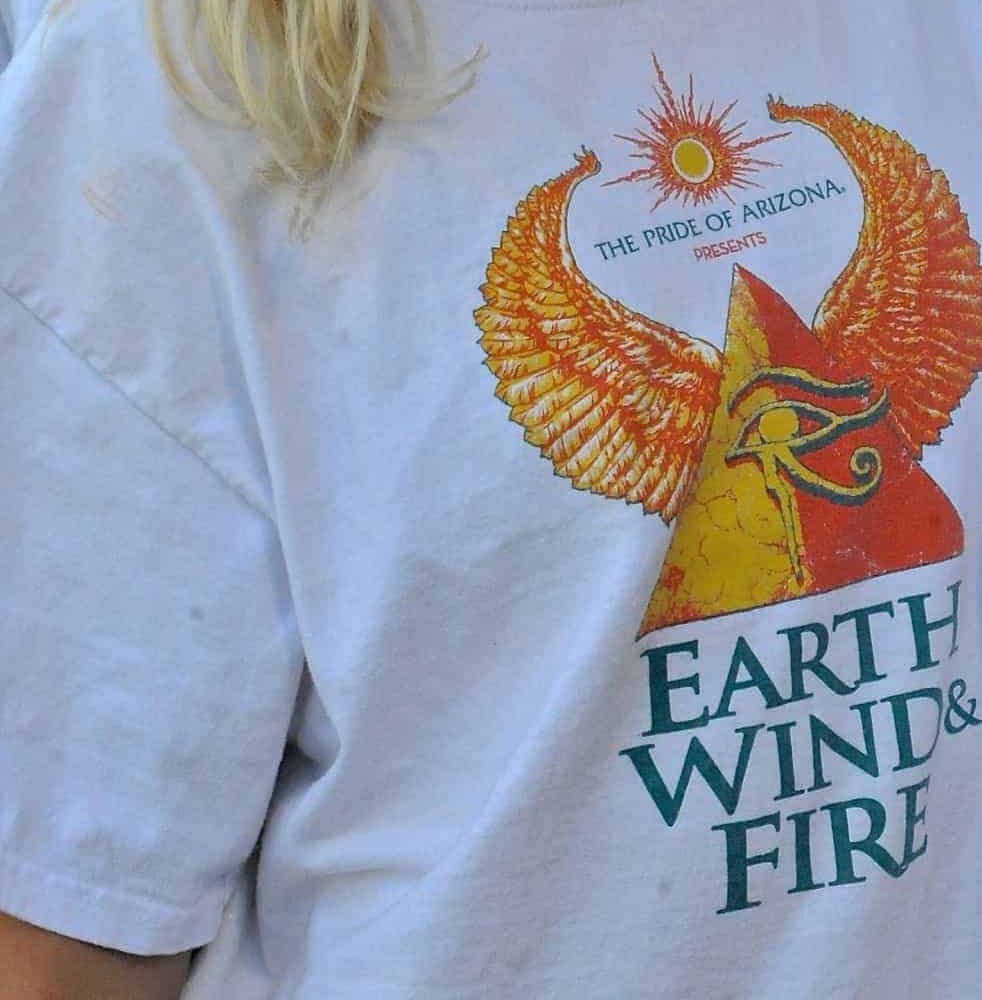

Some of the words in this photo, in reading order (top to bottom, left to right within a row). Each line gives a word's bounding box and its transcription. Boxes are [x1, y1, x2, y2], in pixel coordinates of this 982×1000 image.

[594, 235, 640, 261] THE
[643, 219, 702, 248] PRIDE
[705, 209, 735, 231] OF
[693, 231, 768, 261] PRESENTS
[639, 580, 963, 737] EARTH
[618, 687, 944, 828] WIND
[711, 775, 931, 915] FIRE
